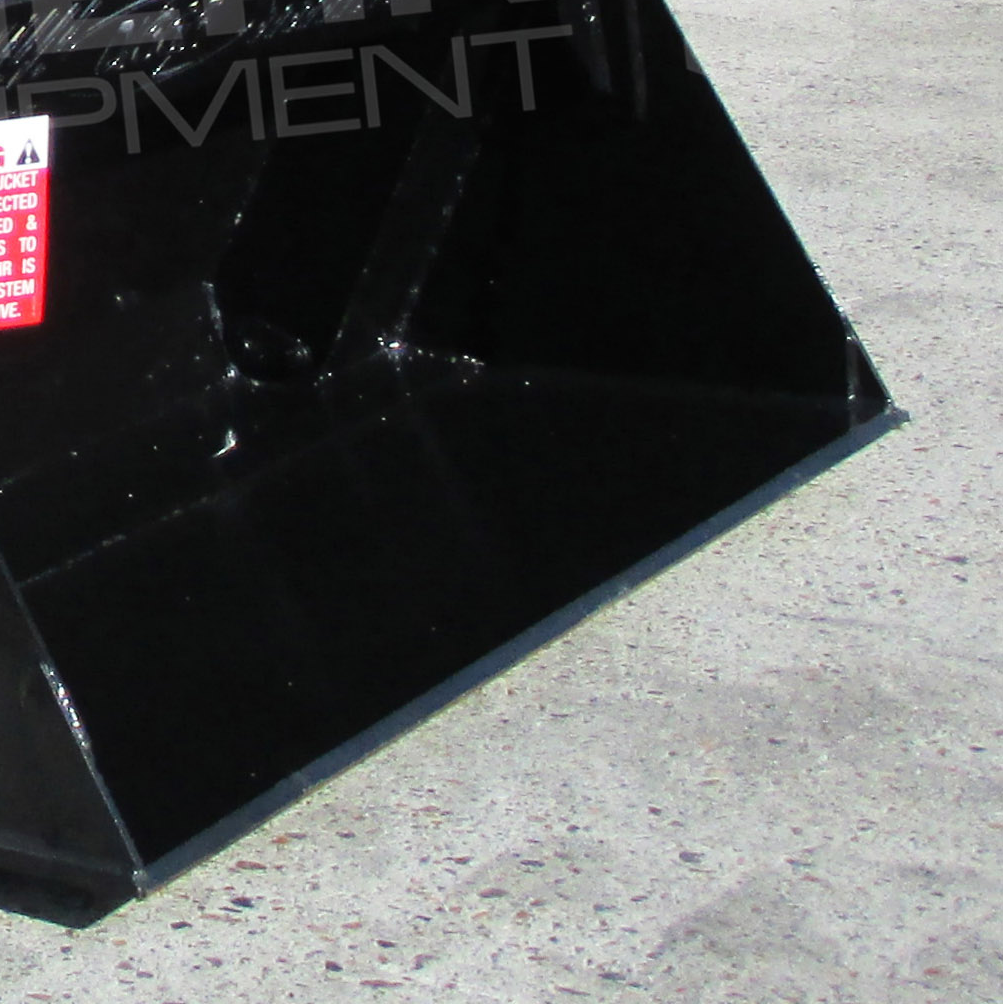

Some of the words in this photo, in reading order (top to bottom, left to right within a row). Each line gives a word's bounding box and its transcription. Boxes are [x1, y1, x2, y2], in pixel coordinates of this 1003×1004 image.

[26, 214, 38, 231] &
[19, 236, 37, 253] TO
[22, 257, 36, 274] IS
